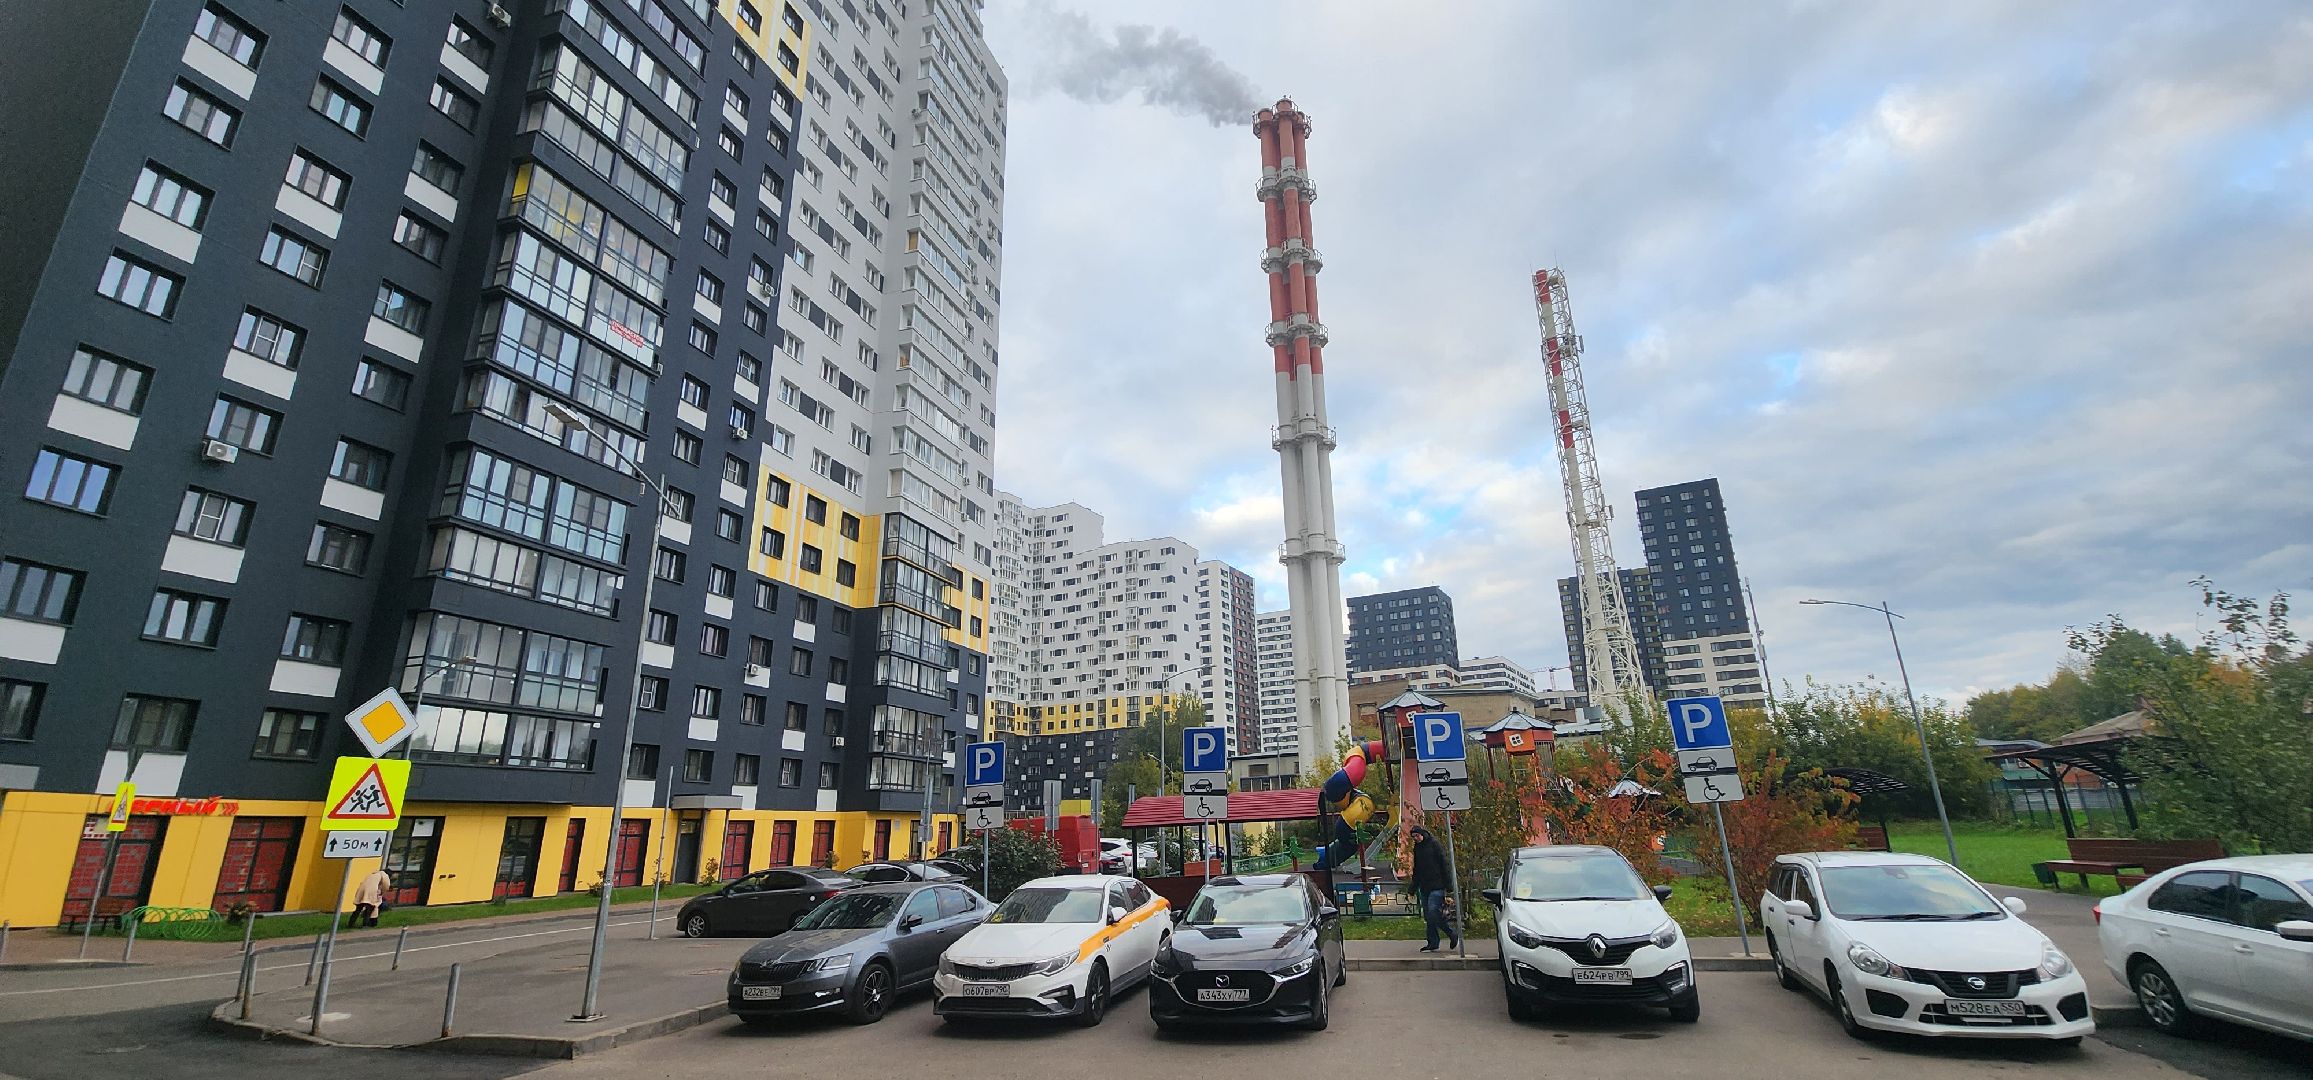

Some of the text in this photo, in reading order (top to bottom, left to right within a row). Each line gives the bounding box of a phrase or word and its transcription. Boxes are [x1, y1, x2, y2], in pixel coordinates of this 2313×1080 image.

[1425, 719, 1451, 755] P
[1680, 704, 1712, 743] P
[975, 748, 996, 780] P
[1194, 733, 1216, 767] P
